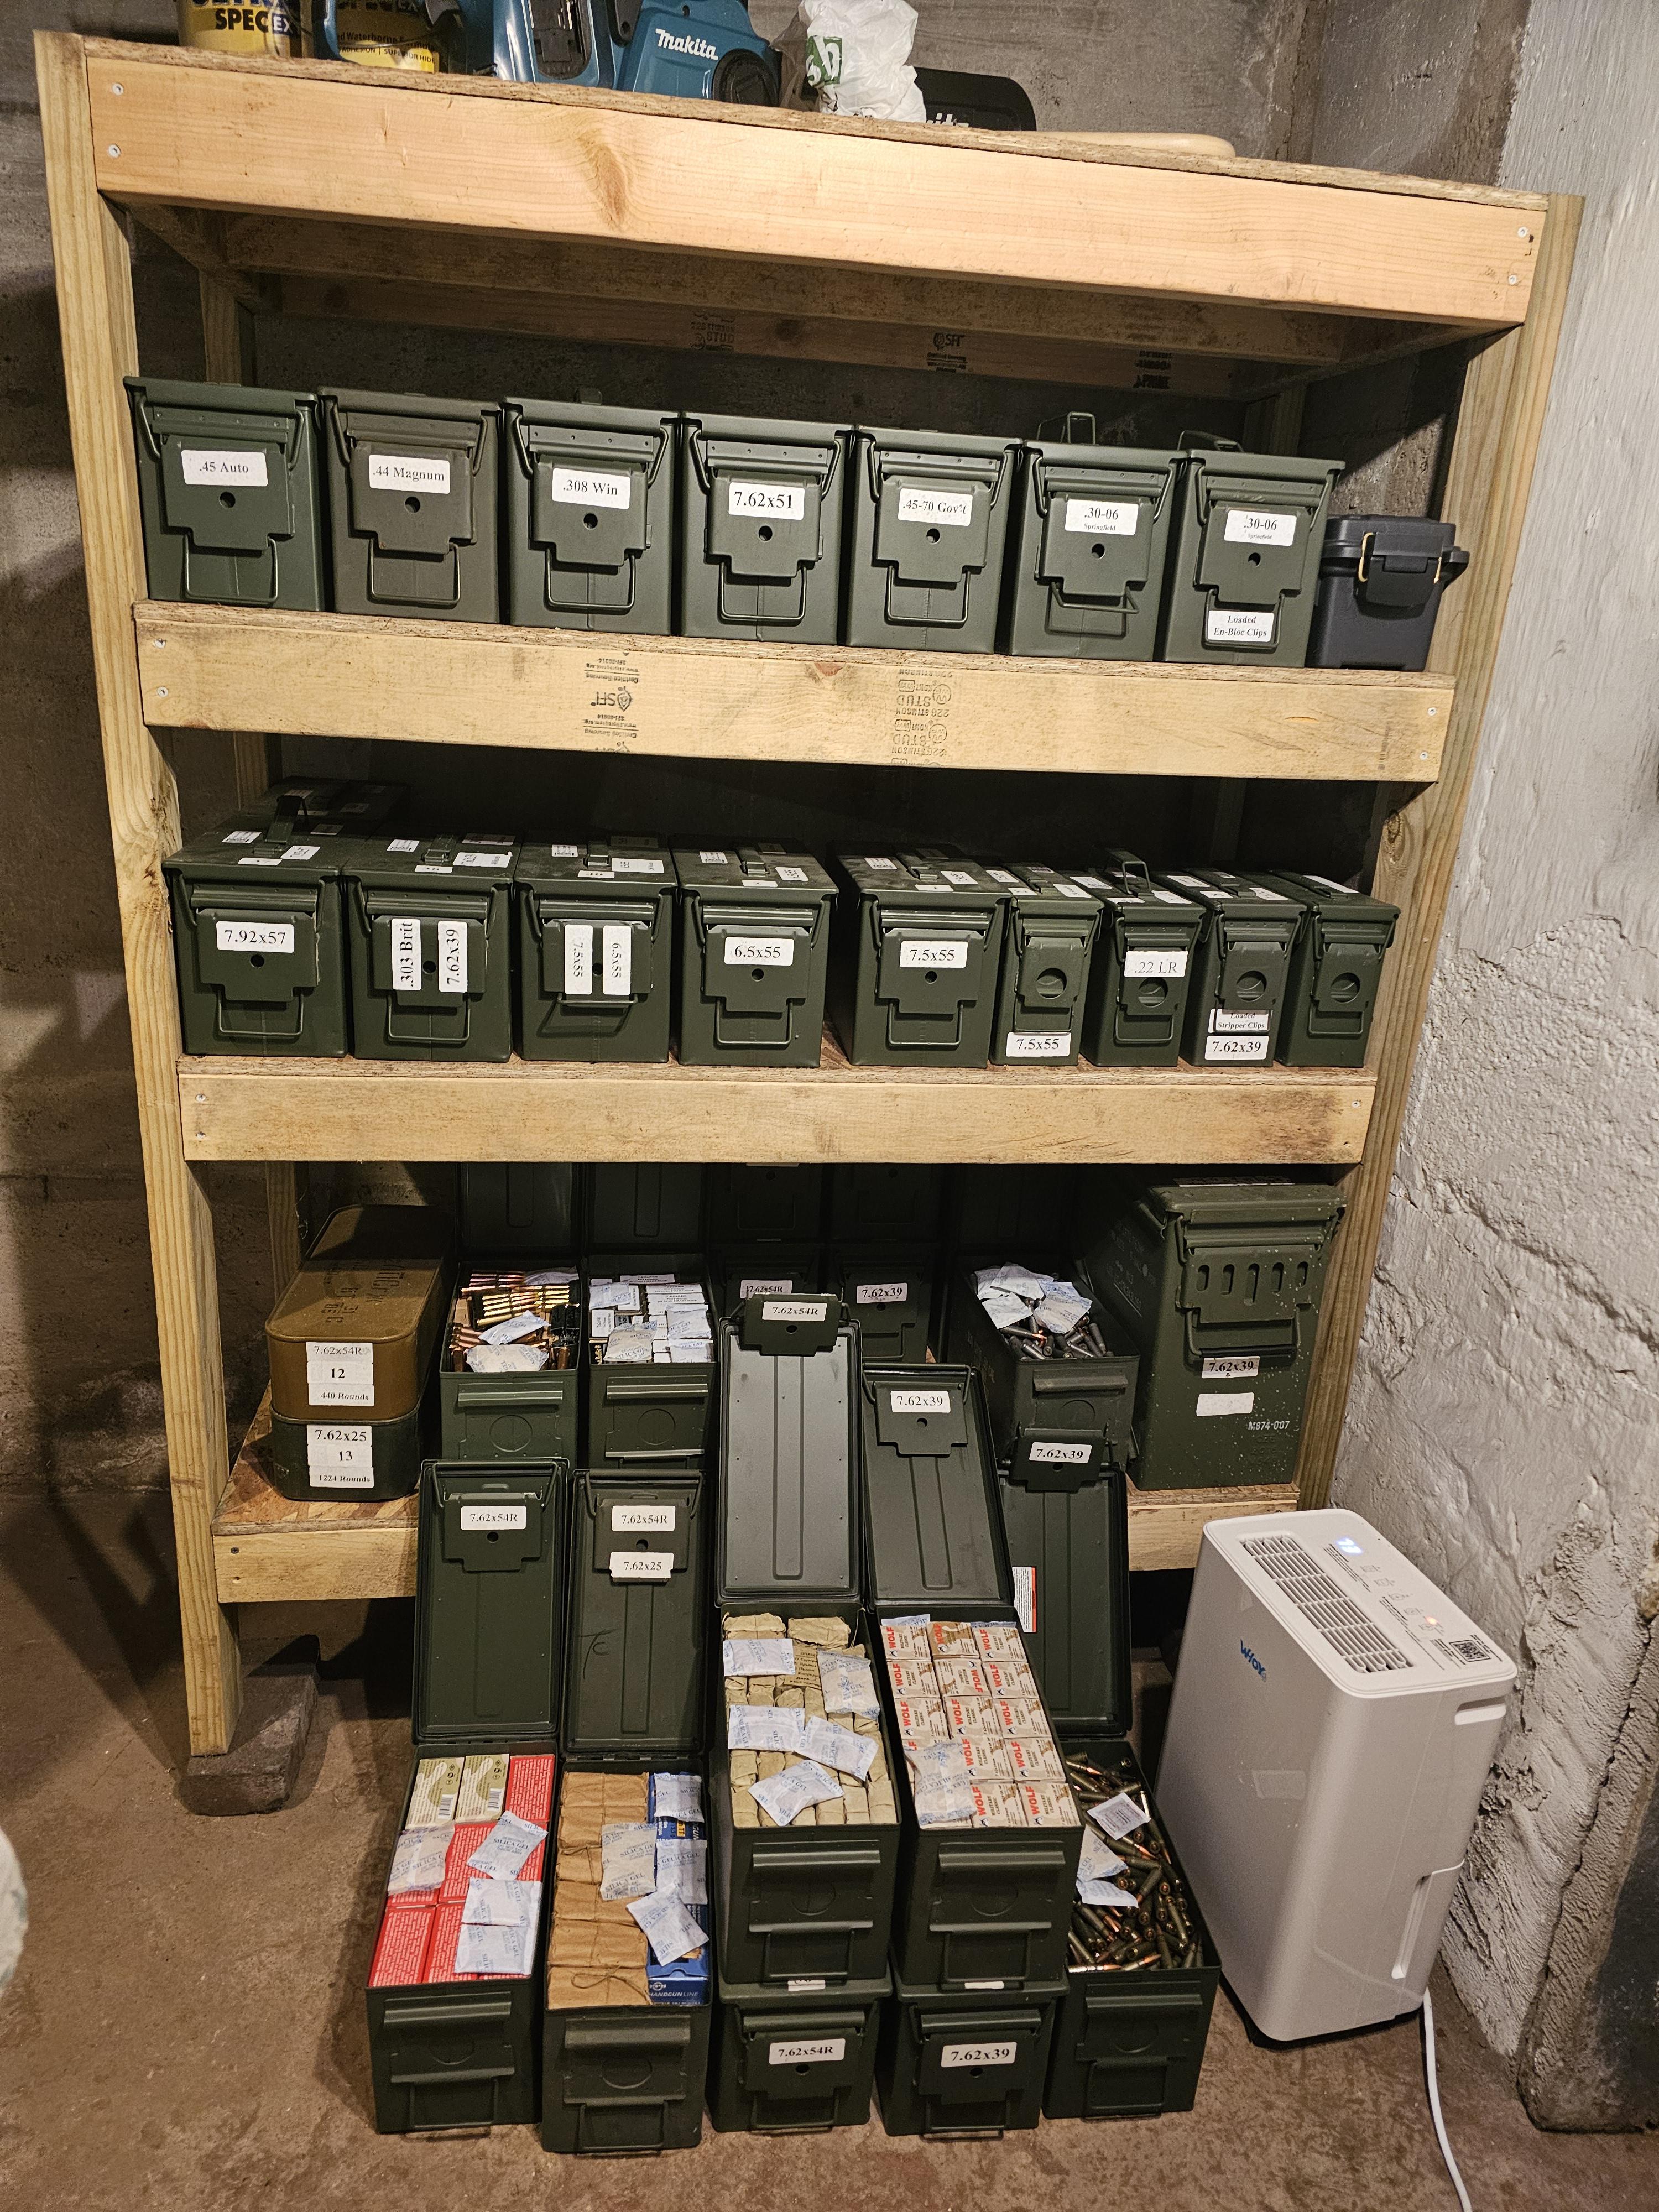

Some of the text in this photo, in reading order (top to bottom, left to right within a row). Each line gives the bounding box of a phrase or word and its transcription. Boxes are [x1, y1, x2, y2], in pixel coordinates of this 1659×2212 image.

[215, 8, 269, 33] SPEC
[655, 28, 719, 61] Makita
[199, 462, 249, 474] .45 Auto
[372, 465, 445, 482] .44 Magnum
[562, 479, 618, 496] .308 Win
[733, 491, 792, 509] 7.62x51
[902, 499, 968, 514] .45-70 Gov't
[1084, 507, 1119, 520] .30-06
[1084, 523, 1116, 532] Springfield
[1244, 518, 1277, 531] .30-06
[1228, 615, 1256, 624] Loaded
[1213, 627, 1267, 639] En-Bloc Clips
[596, 691, 616, 707] SFI
[896, 695, 931, 707] STUD
[893, 734, 927, 747] STUD
[224, 928, 286, 946] 7.92x57
[399, 921, 414, 988] .303 Brit
[446, 928, 460, 985] 7.62x39
[734, 944, 781, 959] 6.5x55
[910, 949, 955, 962] 7.5x55
[572, 942, 584, 978] 7.5x55
[611, 942, 622, 979] 6.5x55
[1134, 961, 1177, 973] .22 LR
[1217, 1021, 1265, 1030] Stripper Clips
[1016, 1037, 1060, 1050] 7.5x55
[1212, 1041, 1261, 1053] 7.62x39
[862, 1286, 903, 1298] 7.62x39
[772, 1306, 818, 1316] 7.62x54R
[314, 1345, 362, 1355] 7.62x54R
[331, 1368, 345, 1379] 12
[1208, 1361, 1254, 1373] 7.62x39
[337, 1392, 369, 1401] Rounds
[896, 1395, 943, 1407] 7.62x39
[314, 1429, 367, 1442] 7.62x25
[338, 1450, 353, 1462] 13
[1036, 1448, 1084, 1460] 7.62x39
[469, 1513, 518, 1523] 7.62x54R
[620, 1514, 667, 1525] 7.62x54R
[623, 1561, 662, 1571] 7.62x25
[886, 1626, 896, 1649] WOLF
[979, 1629, 992, 1651] WOLF
[893, 1663, 904, 1687] WOLF
[970, 1669, 984, 1693] WOLF
[989, 1663, 1003, 1687] WOLF
[900, 1700, 912, 1727] WOLF
[951, 1698, 964, 1725] WOLF
[999, 1700, 1014, 1726] WOLF
[961, 1738, 974, 1766] WOLF
[1010, 1741, 1026, 1768] WOLF
[972, 1786, 987, 1816] WOLF
[1025, 1785, 1040, 1815] WOLF
[494, 1838, 515, 1846] SILICA
[620, 1847, 643, 1858] SILICA
[605, 1872, 645, 1892] SILICA GEL
[778, 2046, 834, 2058] 7.62x54R
[951, 2048, 1011, 2062] 7.62x39
